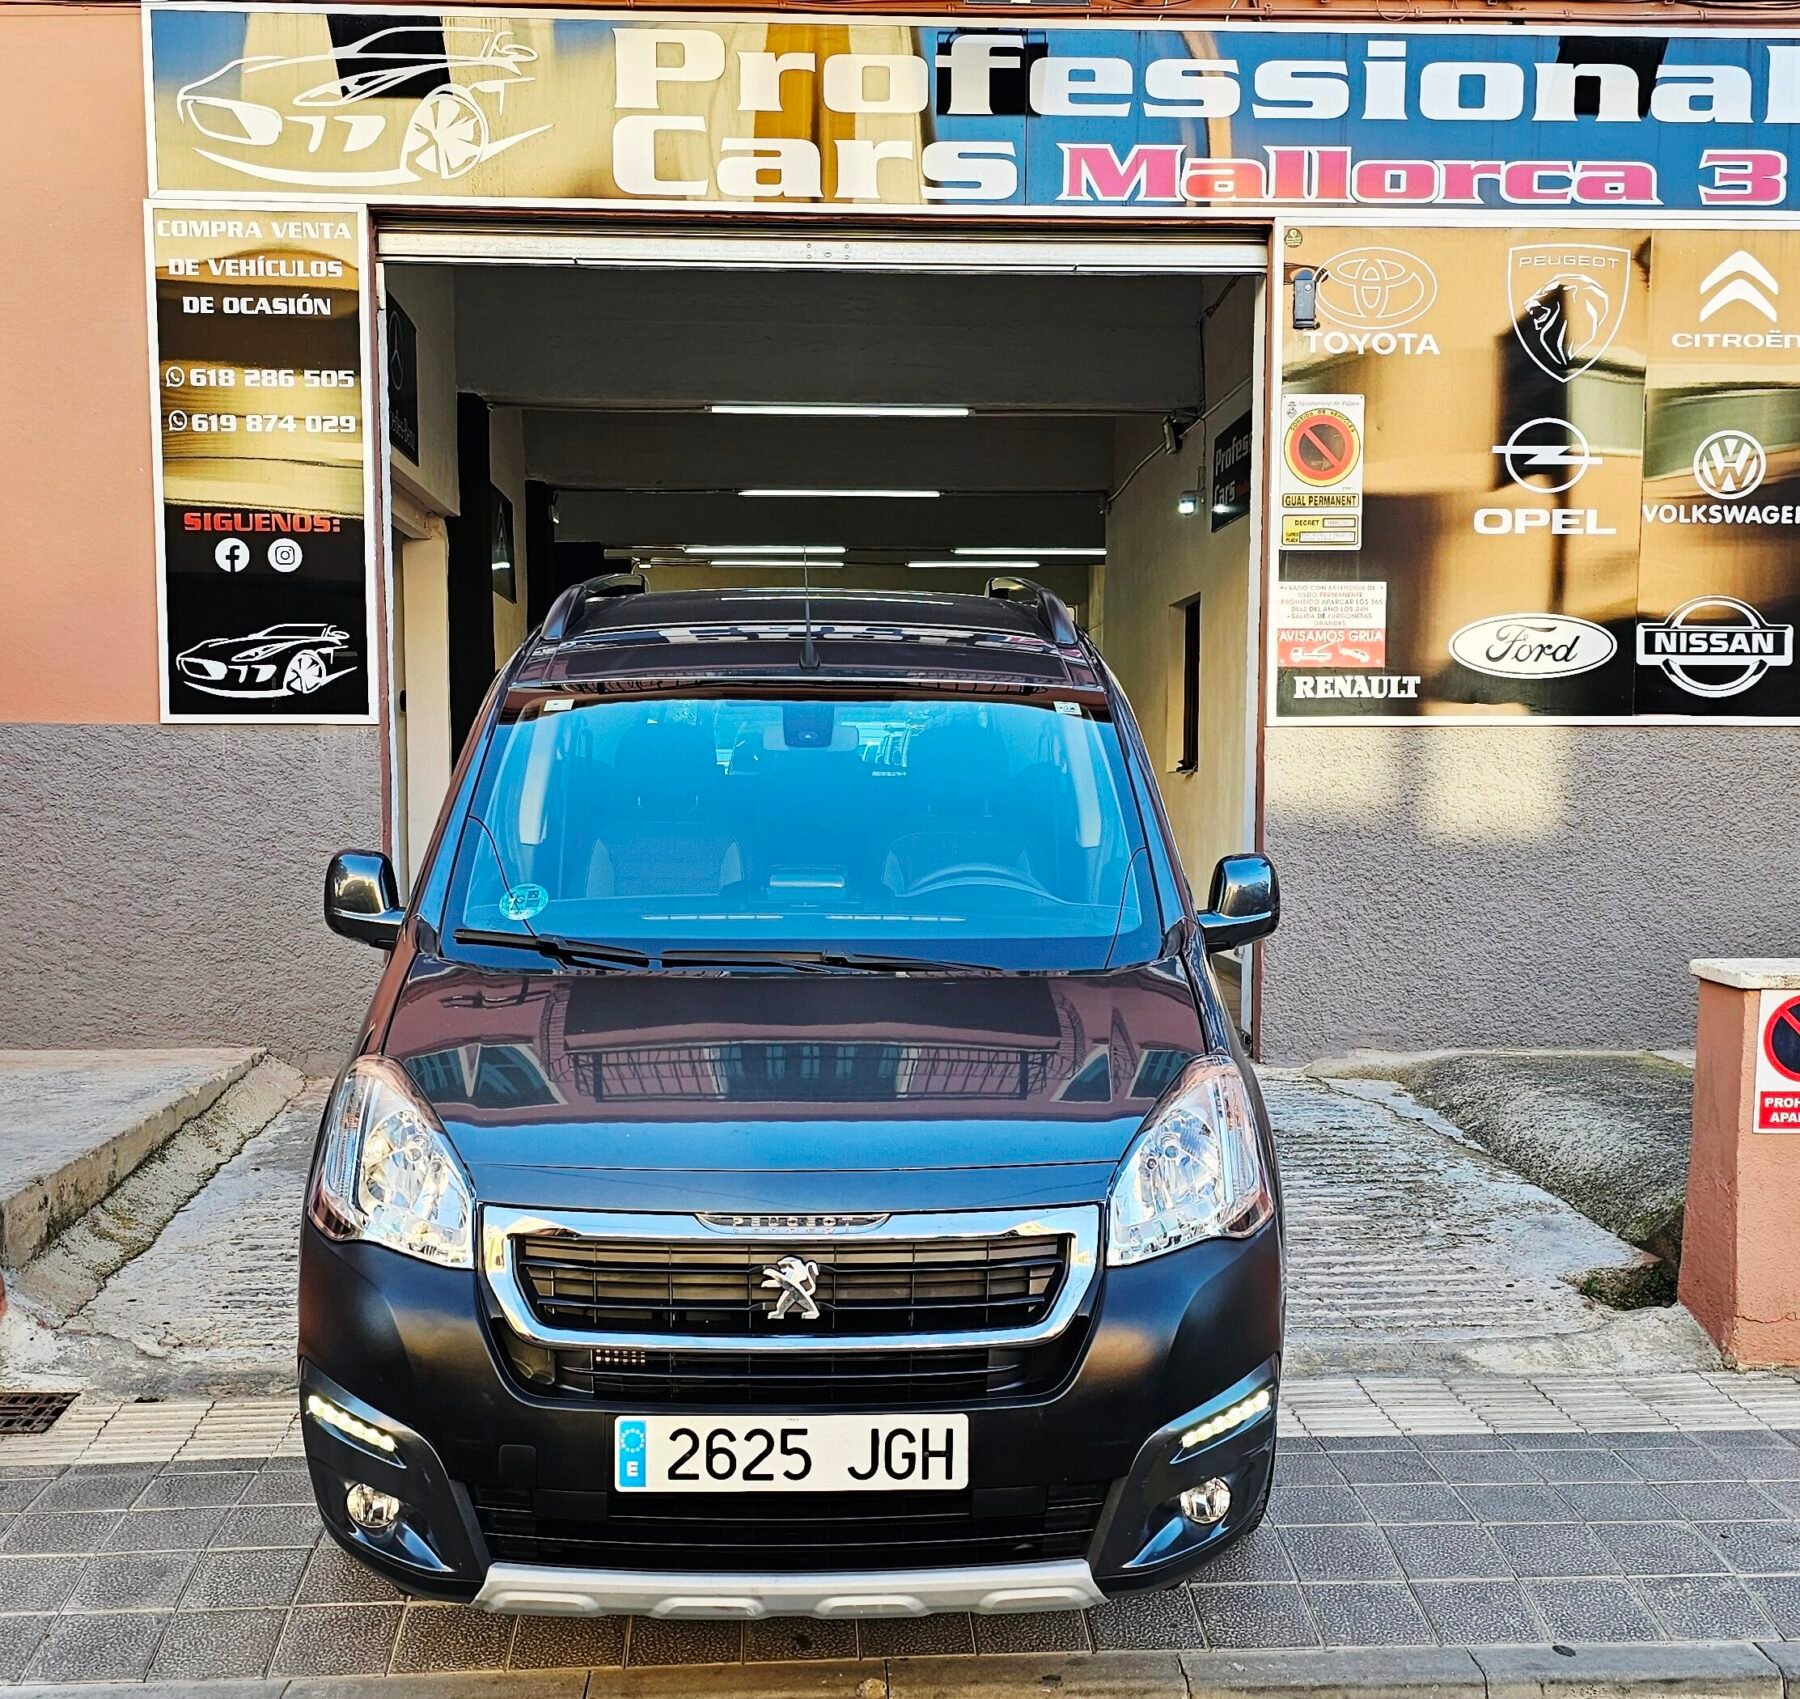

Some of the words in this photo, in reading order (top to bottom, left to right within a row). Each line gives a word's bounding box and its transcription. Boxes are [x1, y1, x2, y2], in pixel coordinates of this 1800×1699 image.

[612, 27, 1800, 124] Professional
[612, 115, 1018, 199] Cars
[1056, 143, 1664, 204] Mallorca
[1699, 149, 1787, 205] 3
[157, 220, 263, 239] COMPRA
[271, 222, 352, 240] VENTA
[168, 258, 199, 276] DE
[207, 256, 343, 277] VEHÍCULOS
[1518, 255, 1620, 269] PEUGEOT
[183, 296, 215, 314] DE
[223, 293, 331, 316] OCASIÓN
[1303, 331, 1440, 355] TOYOTA
[190, 368, 235, 387] 618
[245, 369, 295, 388] 286
[303, 369, 355, 388] 505
[191, 413, 237, 432] 619
[245, 414, 297, 433] 874
[306, 415, 356, 433] 029
[1215, 432, 1252, 477] Profes
[1285, 495, 1307, 506] GUAL
[1308, 495, 1357, 507] PERMANENT
[183, 512, 341, 533] SIGUENOS:
[1473, 508, 1617, 535] OPEL
[1279, 630, 1345, 642] AVISAMOS
[1348, 630, 1384, 641] GRUA
[1486, 624, 1581, 663] Ford
[1654, 632, 1774, 654] NISSAN
[1293, 675, 1421, 699] RENAULT
[626, 1461, 639, 1477] E
[667, 1428, 812, 1481] 2625
[847, 1428, 954, 1481] JGH
